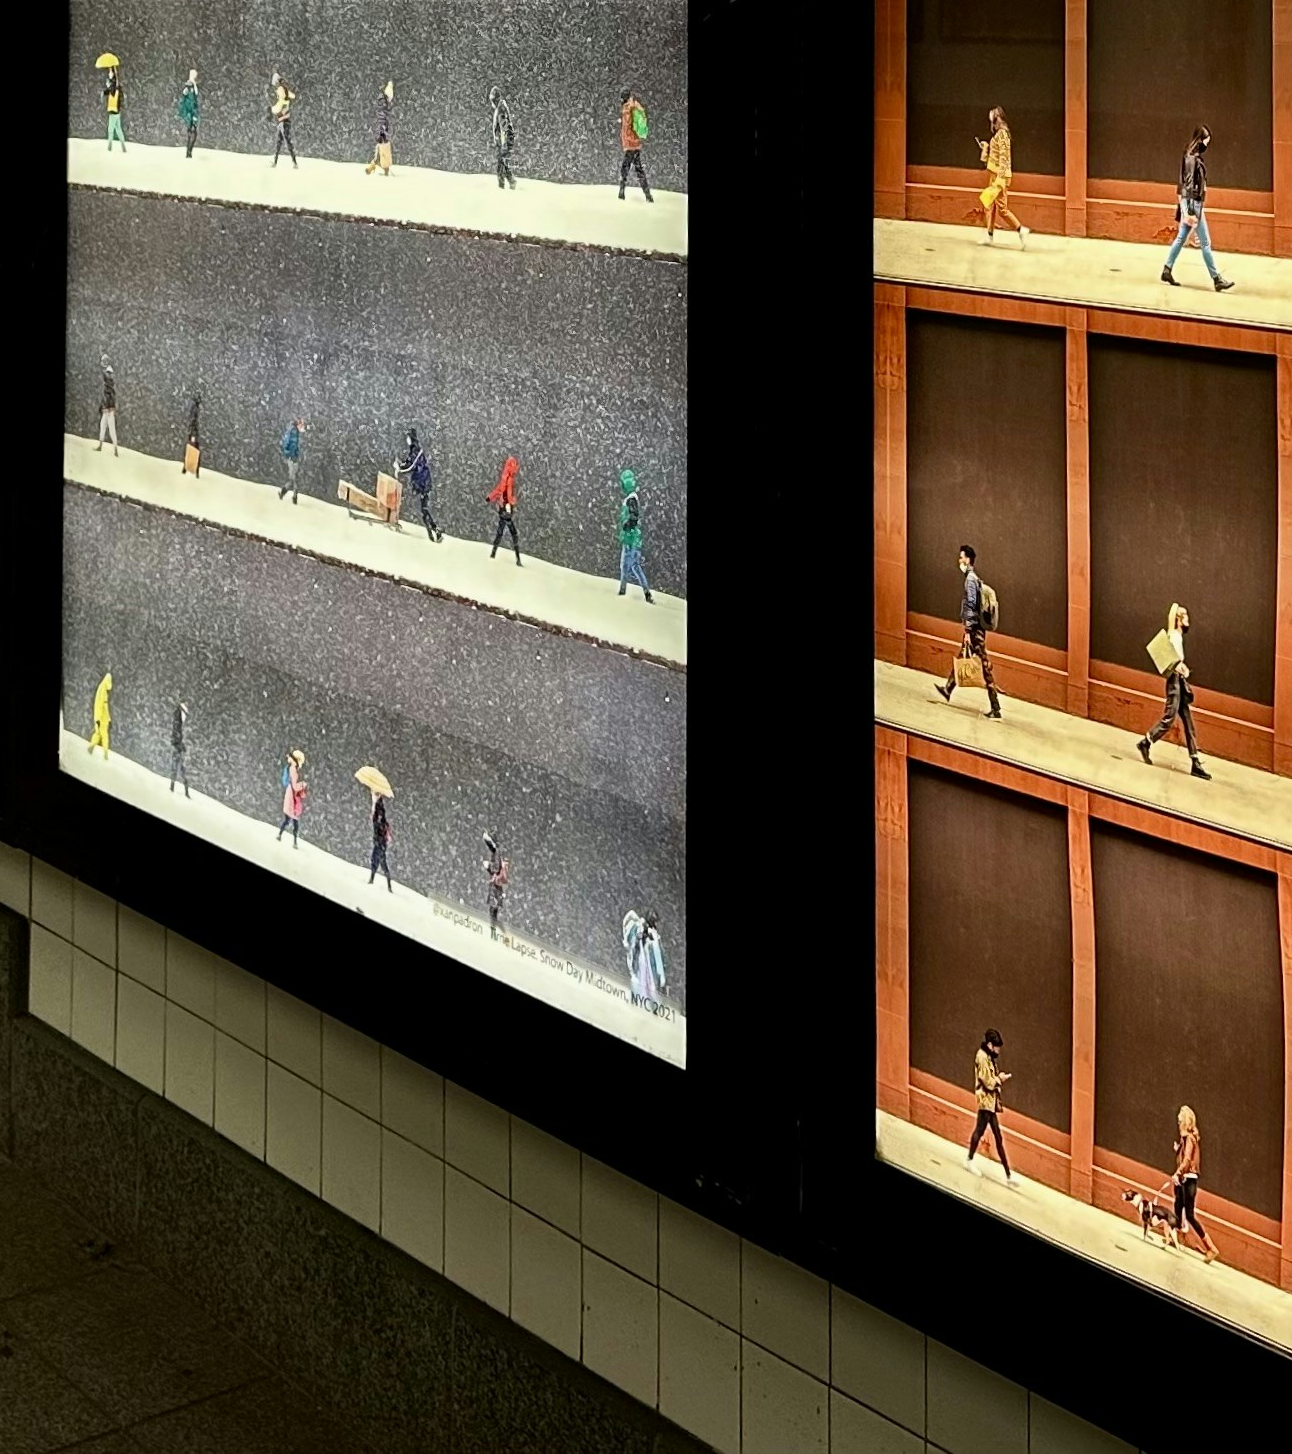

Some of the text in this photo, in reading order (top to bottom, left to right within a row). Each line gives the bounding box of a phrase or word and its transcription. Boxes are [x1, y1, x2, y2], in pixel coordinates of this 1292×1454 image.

[490, 926, 510, 947] Time
[539, 949, 564, 971] Snow
[566, 961, 583, 983] Day
[630, 990, 652, 1012] NYC
[652, 1001, 676, 1023] 2021
